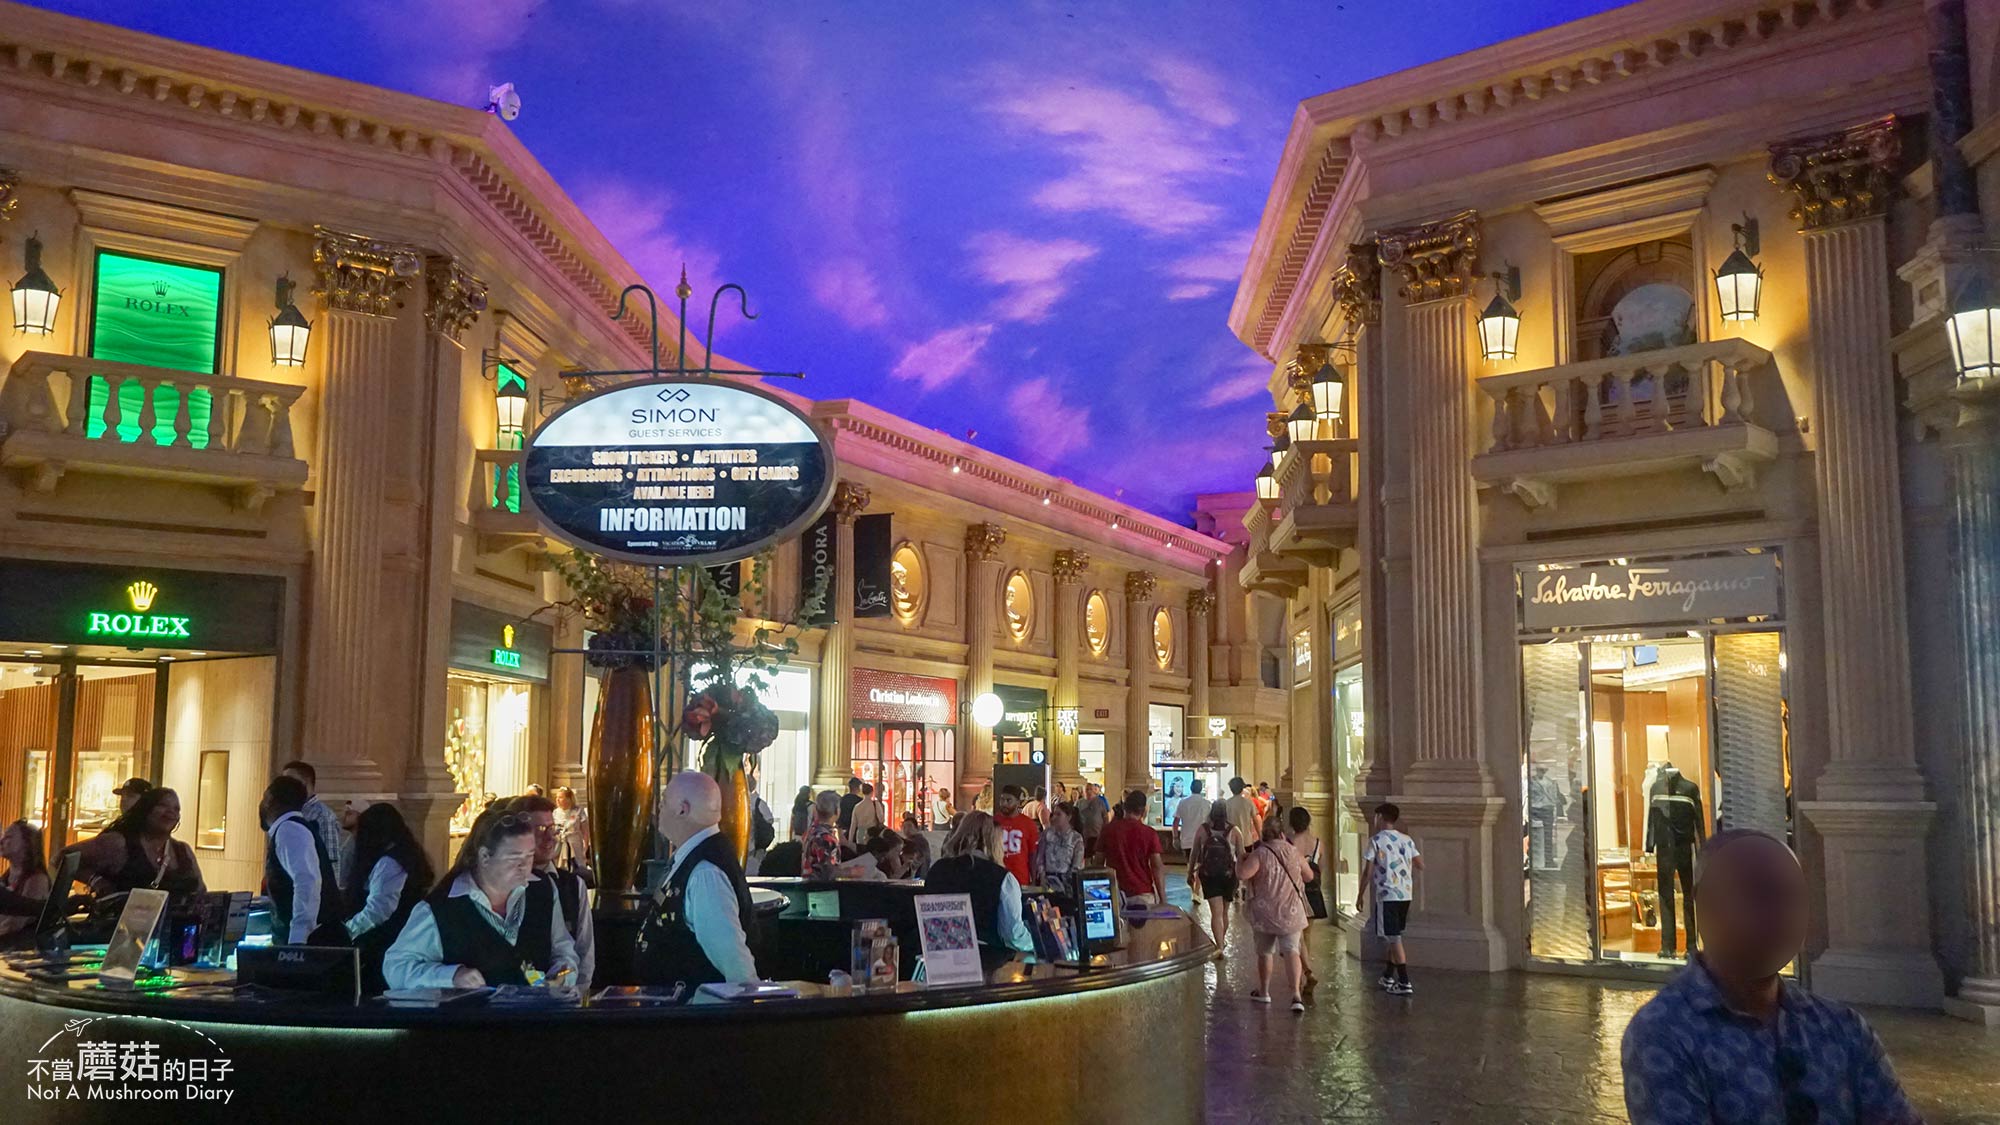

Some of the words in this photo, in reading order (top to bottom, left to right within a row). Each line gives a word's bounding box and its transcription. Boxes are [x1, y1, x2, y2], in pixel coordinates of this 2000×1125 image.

[126, 297, 190, 318] ROLEX
[628, 429, 665, 438] GUEST
[668, 428, 722, 437] SERVICES
[592, 452, 629, 465] SHOW
[630, 451, 678, 464] TICKETS
[692, 449, 758, 464] ACTIVITIES
[550, 468, 623, 483] EXCURSIONS
[636, 467, 716, 481] ATTRACTIONS
[731, 466, 758, 480] GIFT
[758, 466, 799, 480] CARDS
[633, 486, 687, 499] AVAILABLE
[600, 507, 746, 531] INFORMATION
[814, 525, 828, 615] ADORA
[1531, 573, 1627, 604] Salvatore
[1628, 569, 1765, 612] Ferragamo
[89, 612, 190, 636] ROLEX
[494, 649, 521, 668] ROLEX
[277, 951, 305, 962] DELL
